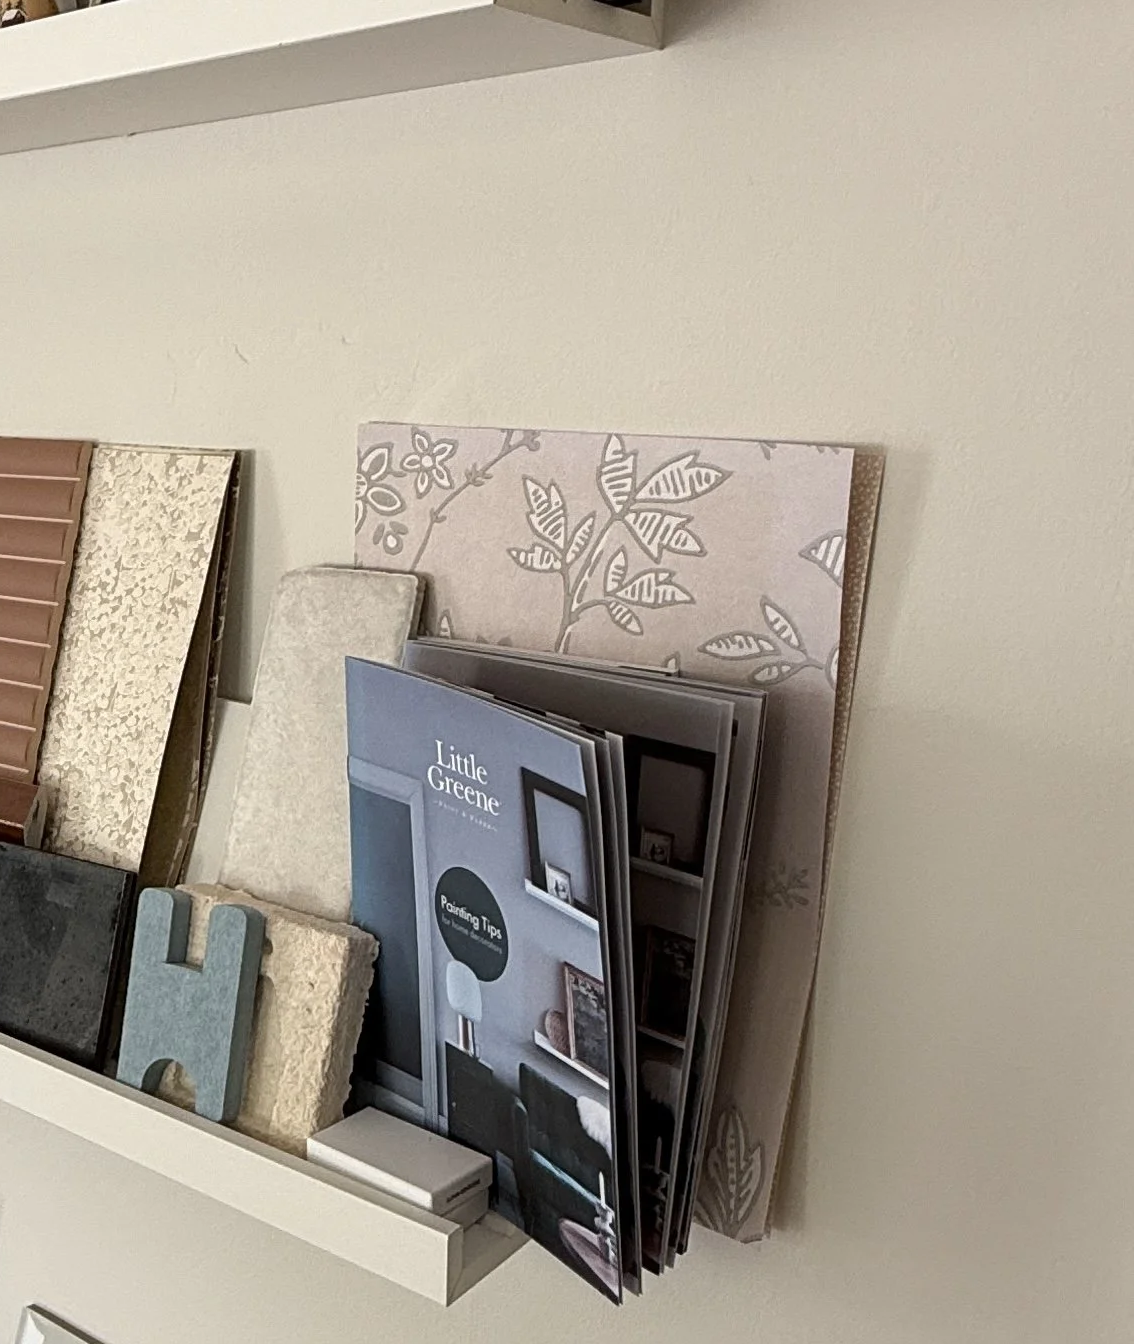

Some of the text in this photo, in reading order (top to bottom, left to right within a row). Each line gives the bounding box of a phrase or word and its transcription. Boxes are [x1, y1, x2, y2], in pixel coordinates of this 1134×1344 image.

[435, 739, 488, 785] Little
[427, 765, 501, 816] Greene
[440, 894, 503, 940] Painting Tips
